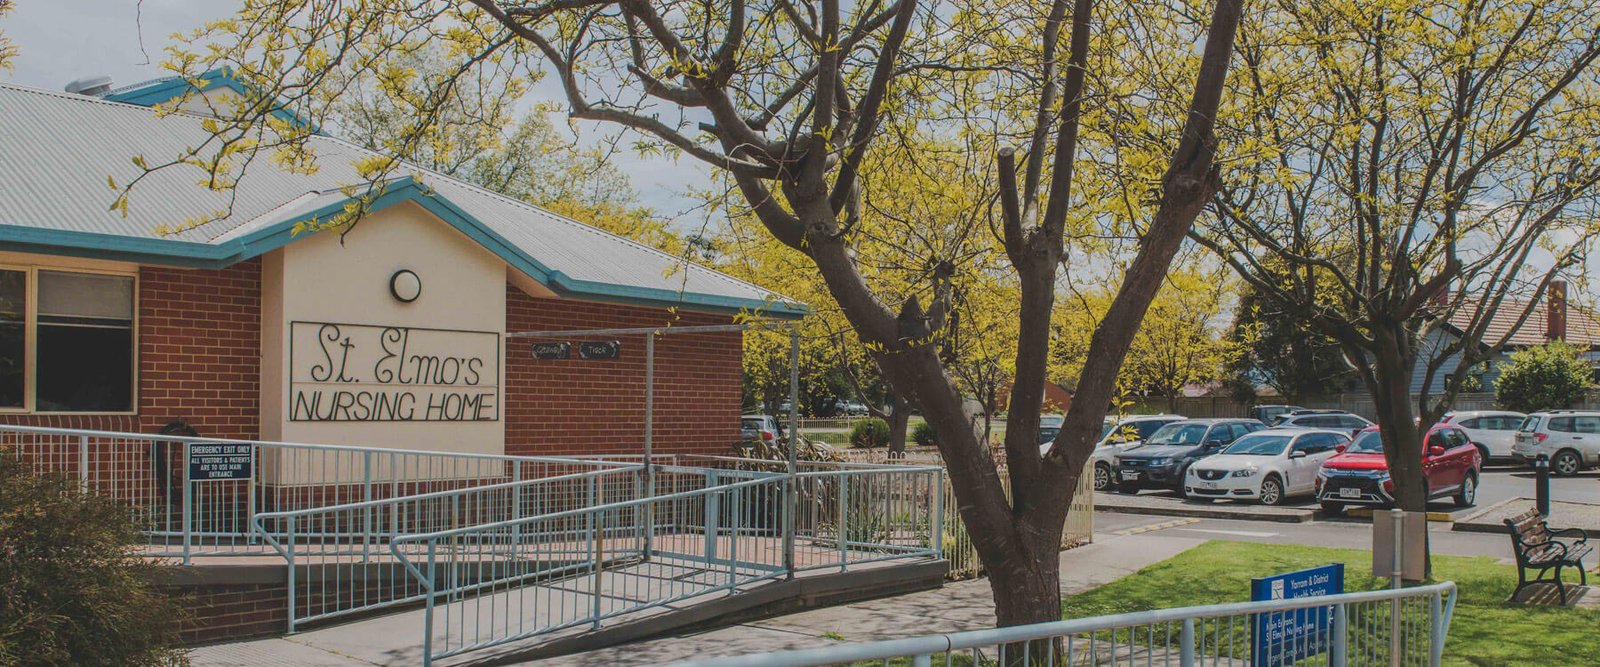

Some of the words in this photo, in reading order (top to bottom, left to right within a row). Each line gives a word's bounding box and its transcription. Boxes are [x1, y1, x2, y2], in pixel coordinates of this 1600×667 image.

[311, 323, 360, 383] St.
[374, 327, 483, 386] Elmo's
[293, 390, 416, 420] NURSING
[425, 392, 495, 420] HOME
[191, 446, 222, 454] EMERGENCY
[223, 446, 236, 454] EXIT
[237, 446, 250, 454] ONLY
[229, 456, 250, 464] PATIENTS
[208, 470, 233, 478] ENTRANCE
[1291, 579, 1308, 590] Yarram
[1309, 576, 1313, 586] &
[1314, 574, 1329, 584] District
